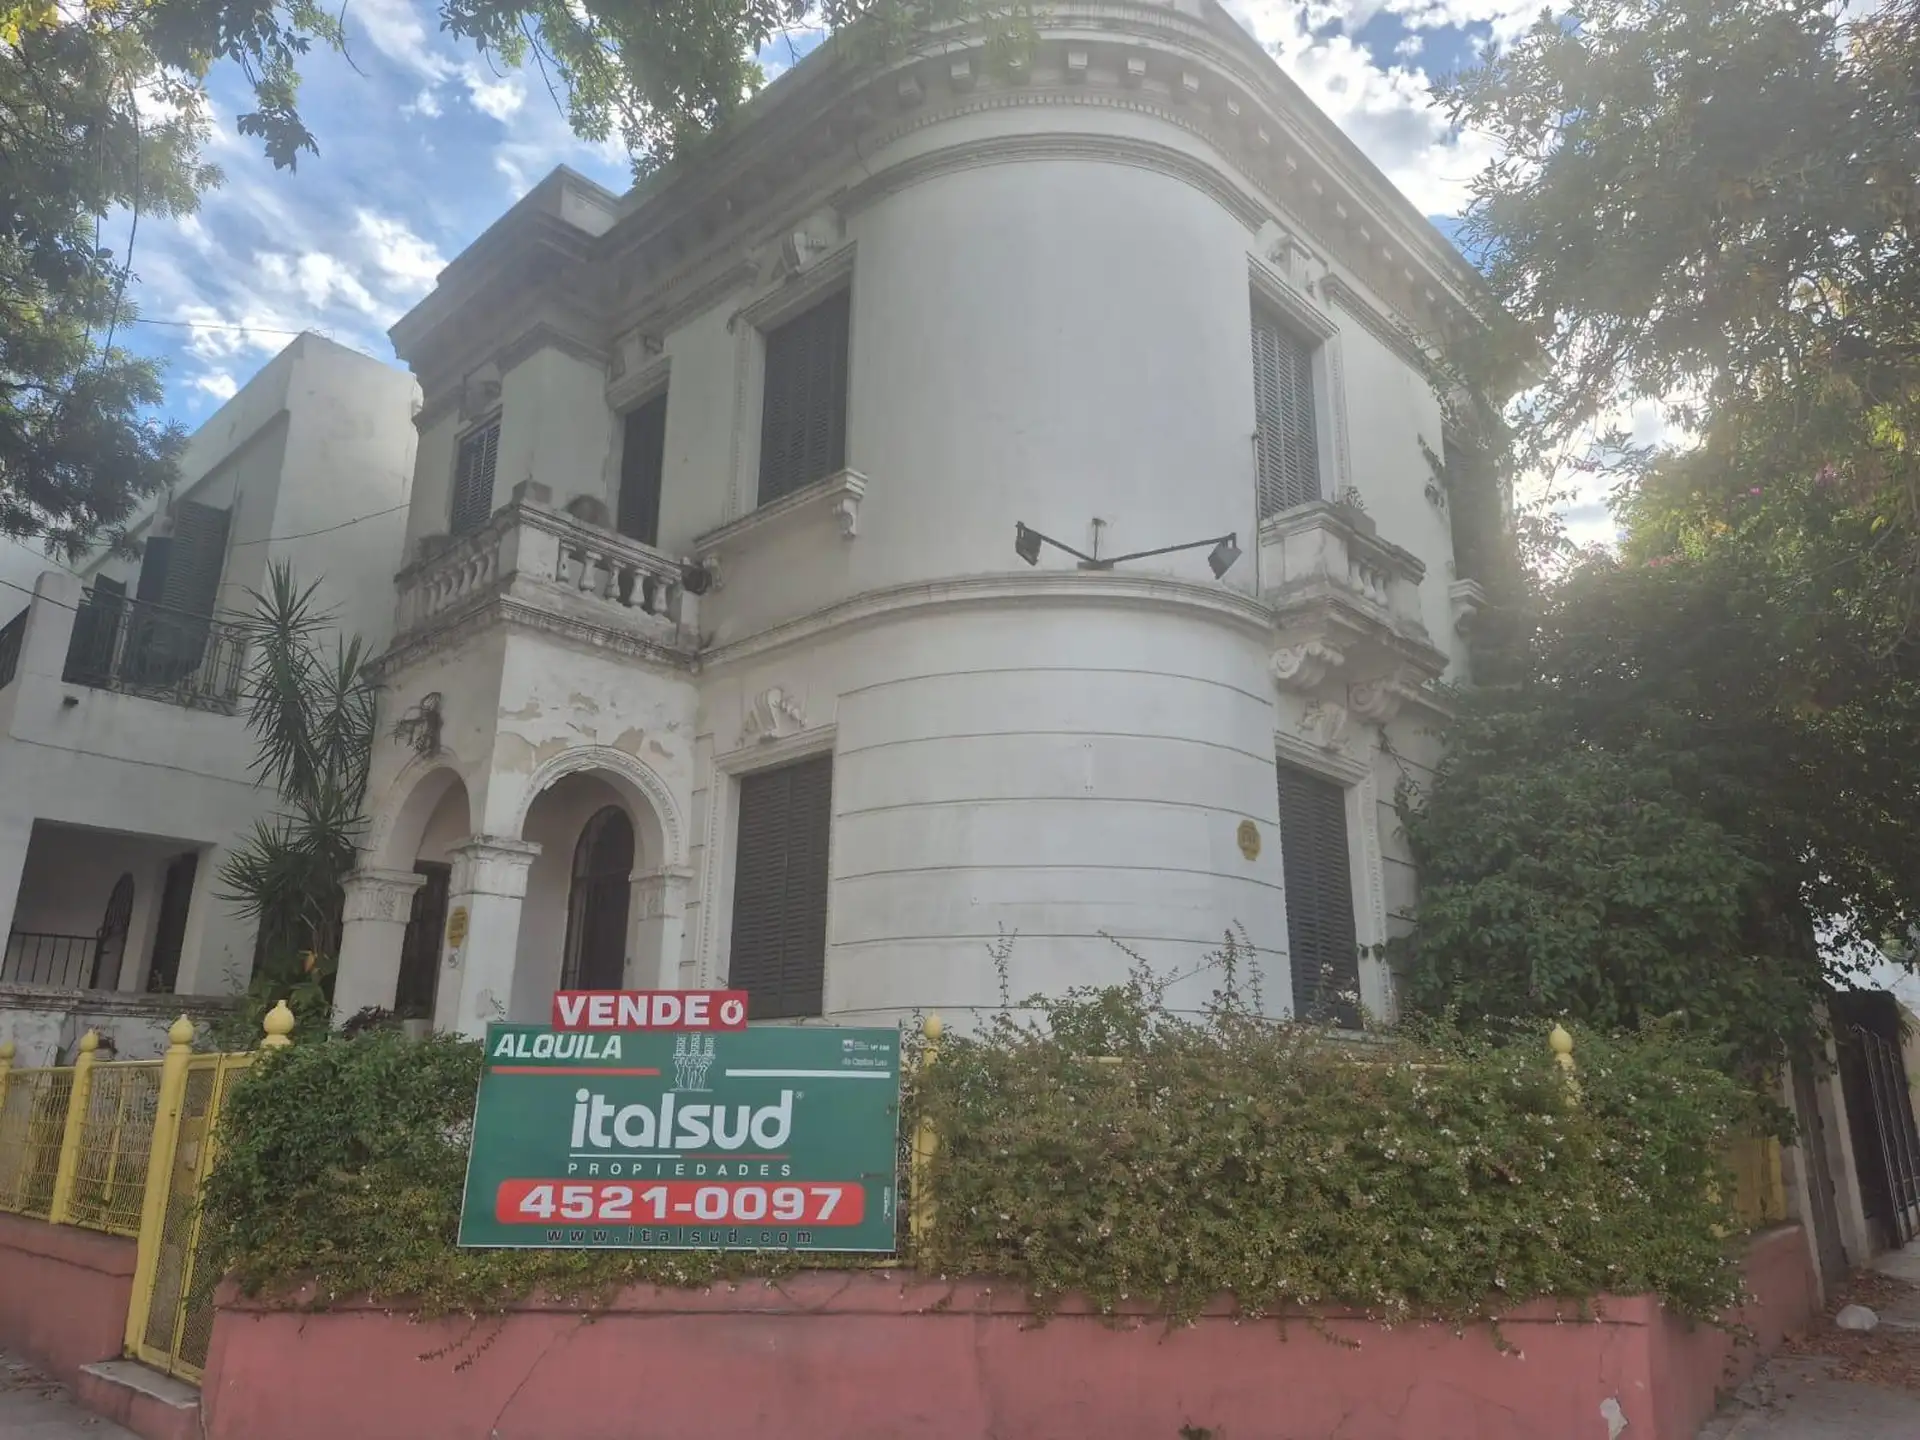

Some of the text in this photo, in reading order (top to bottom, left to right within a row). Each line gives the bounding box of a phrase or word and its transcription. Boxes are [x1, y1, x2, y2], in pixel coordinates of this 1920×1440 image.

[557, 995, 710, 1026] VENDE
[494, 1033, 622, 1059] ALQUILA
[570, 1088, 793, 1149] italsud
[568, 1163, 791, 1176] PROPIEDADES
[519, 1185, 842, 1220] 4521-0097
[547, 1228, 812, 1244] www.italsud.com
